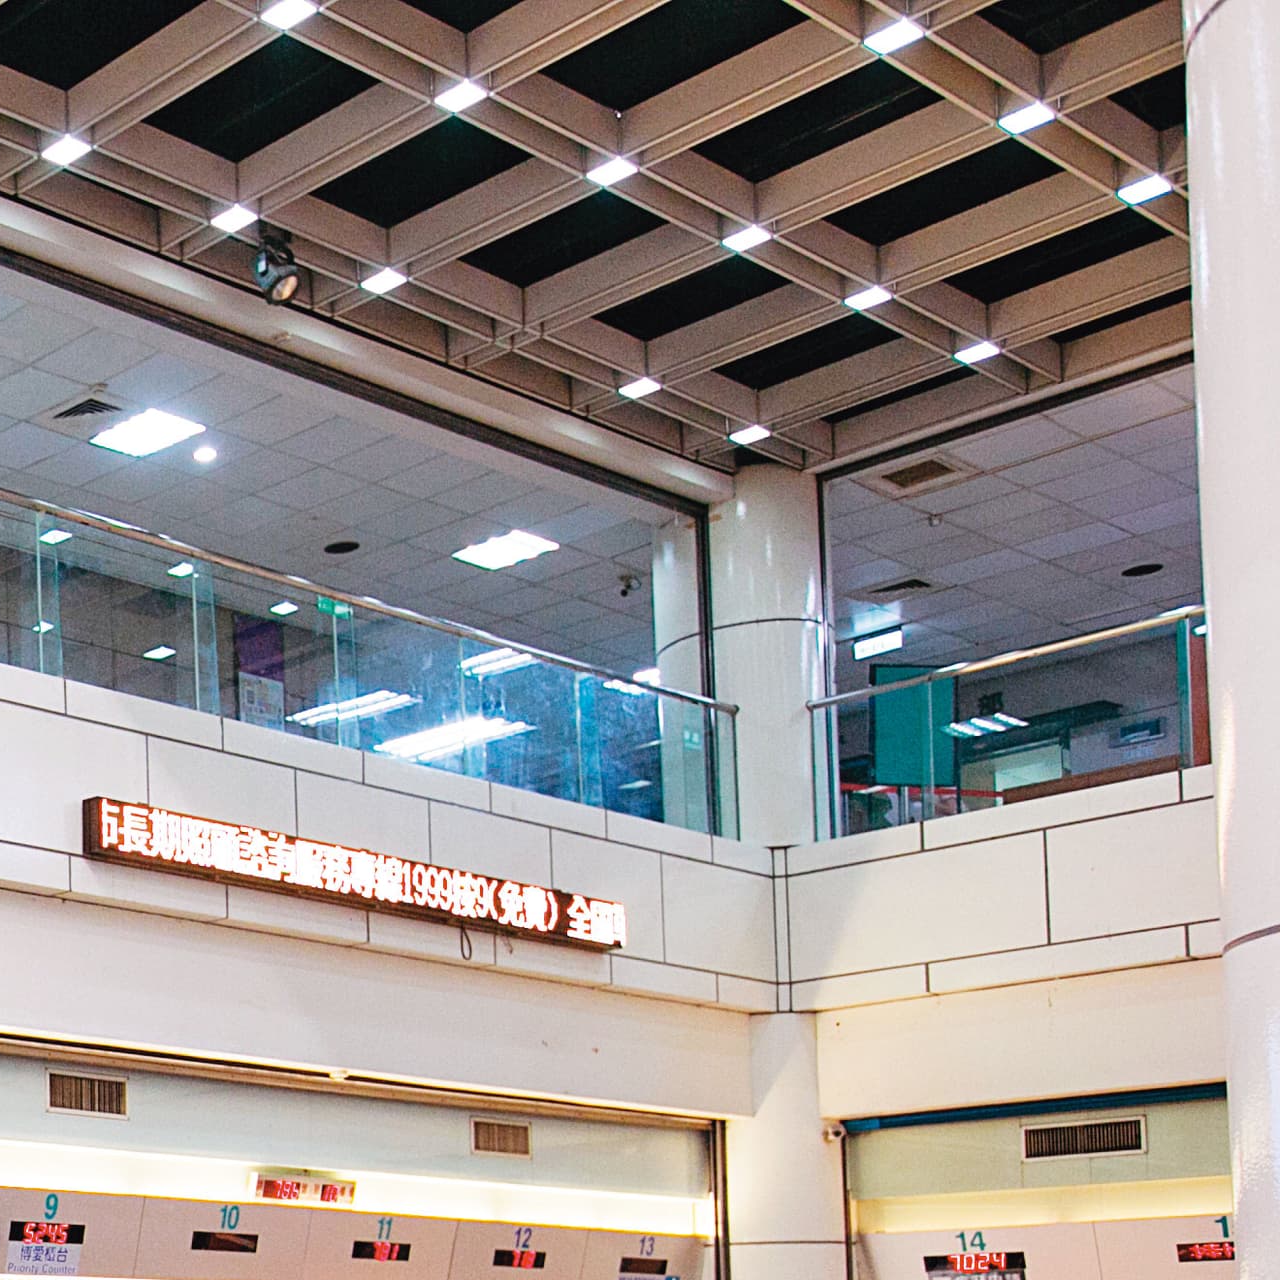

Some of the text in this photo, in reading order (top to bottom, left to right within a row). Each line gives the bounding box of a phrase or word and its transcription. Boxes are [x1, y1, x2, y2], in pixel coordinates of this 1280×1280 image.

[44, 1193, 59, 1219] 9
[220, 1205, 240, 1229] 10
[23, 1222, 68, 1244] 5245
[377, 1217, 393, 1240] 11
[514, 1227, 533, 1248] 12
[639, 1235, 656, 1256] 13
[955, 1231, 987, 1251] 14
[20, 1246, 70, 1263] 博愛櫃台
[950, 1252, 1006, 1271] 7024
[7, 1262, 76, 1275] Priority Counter
